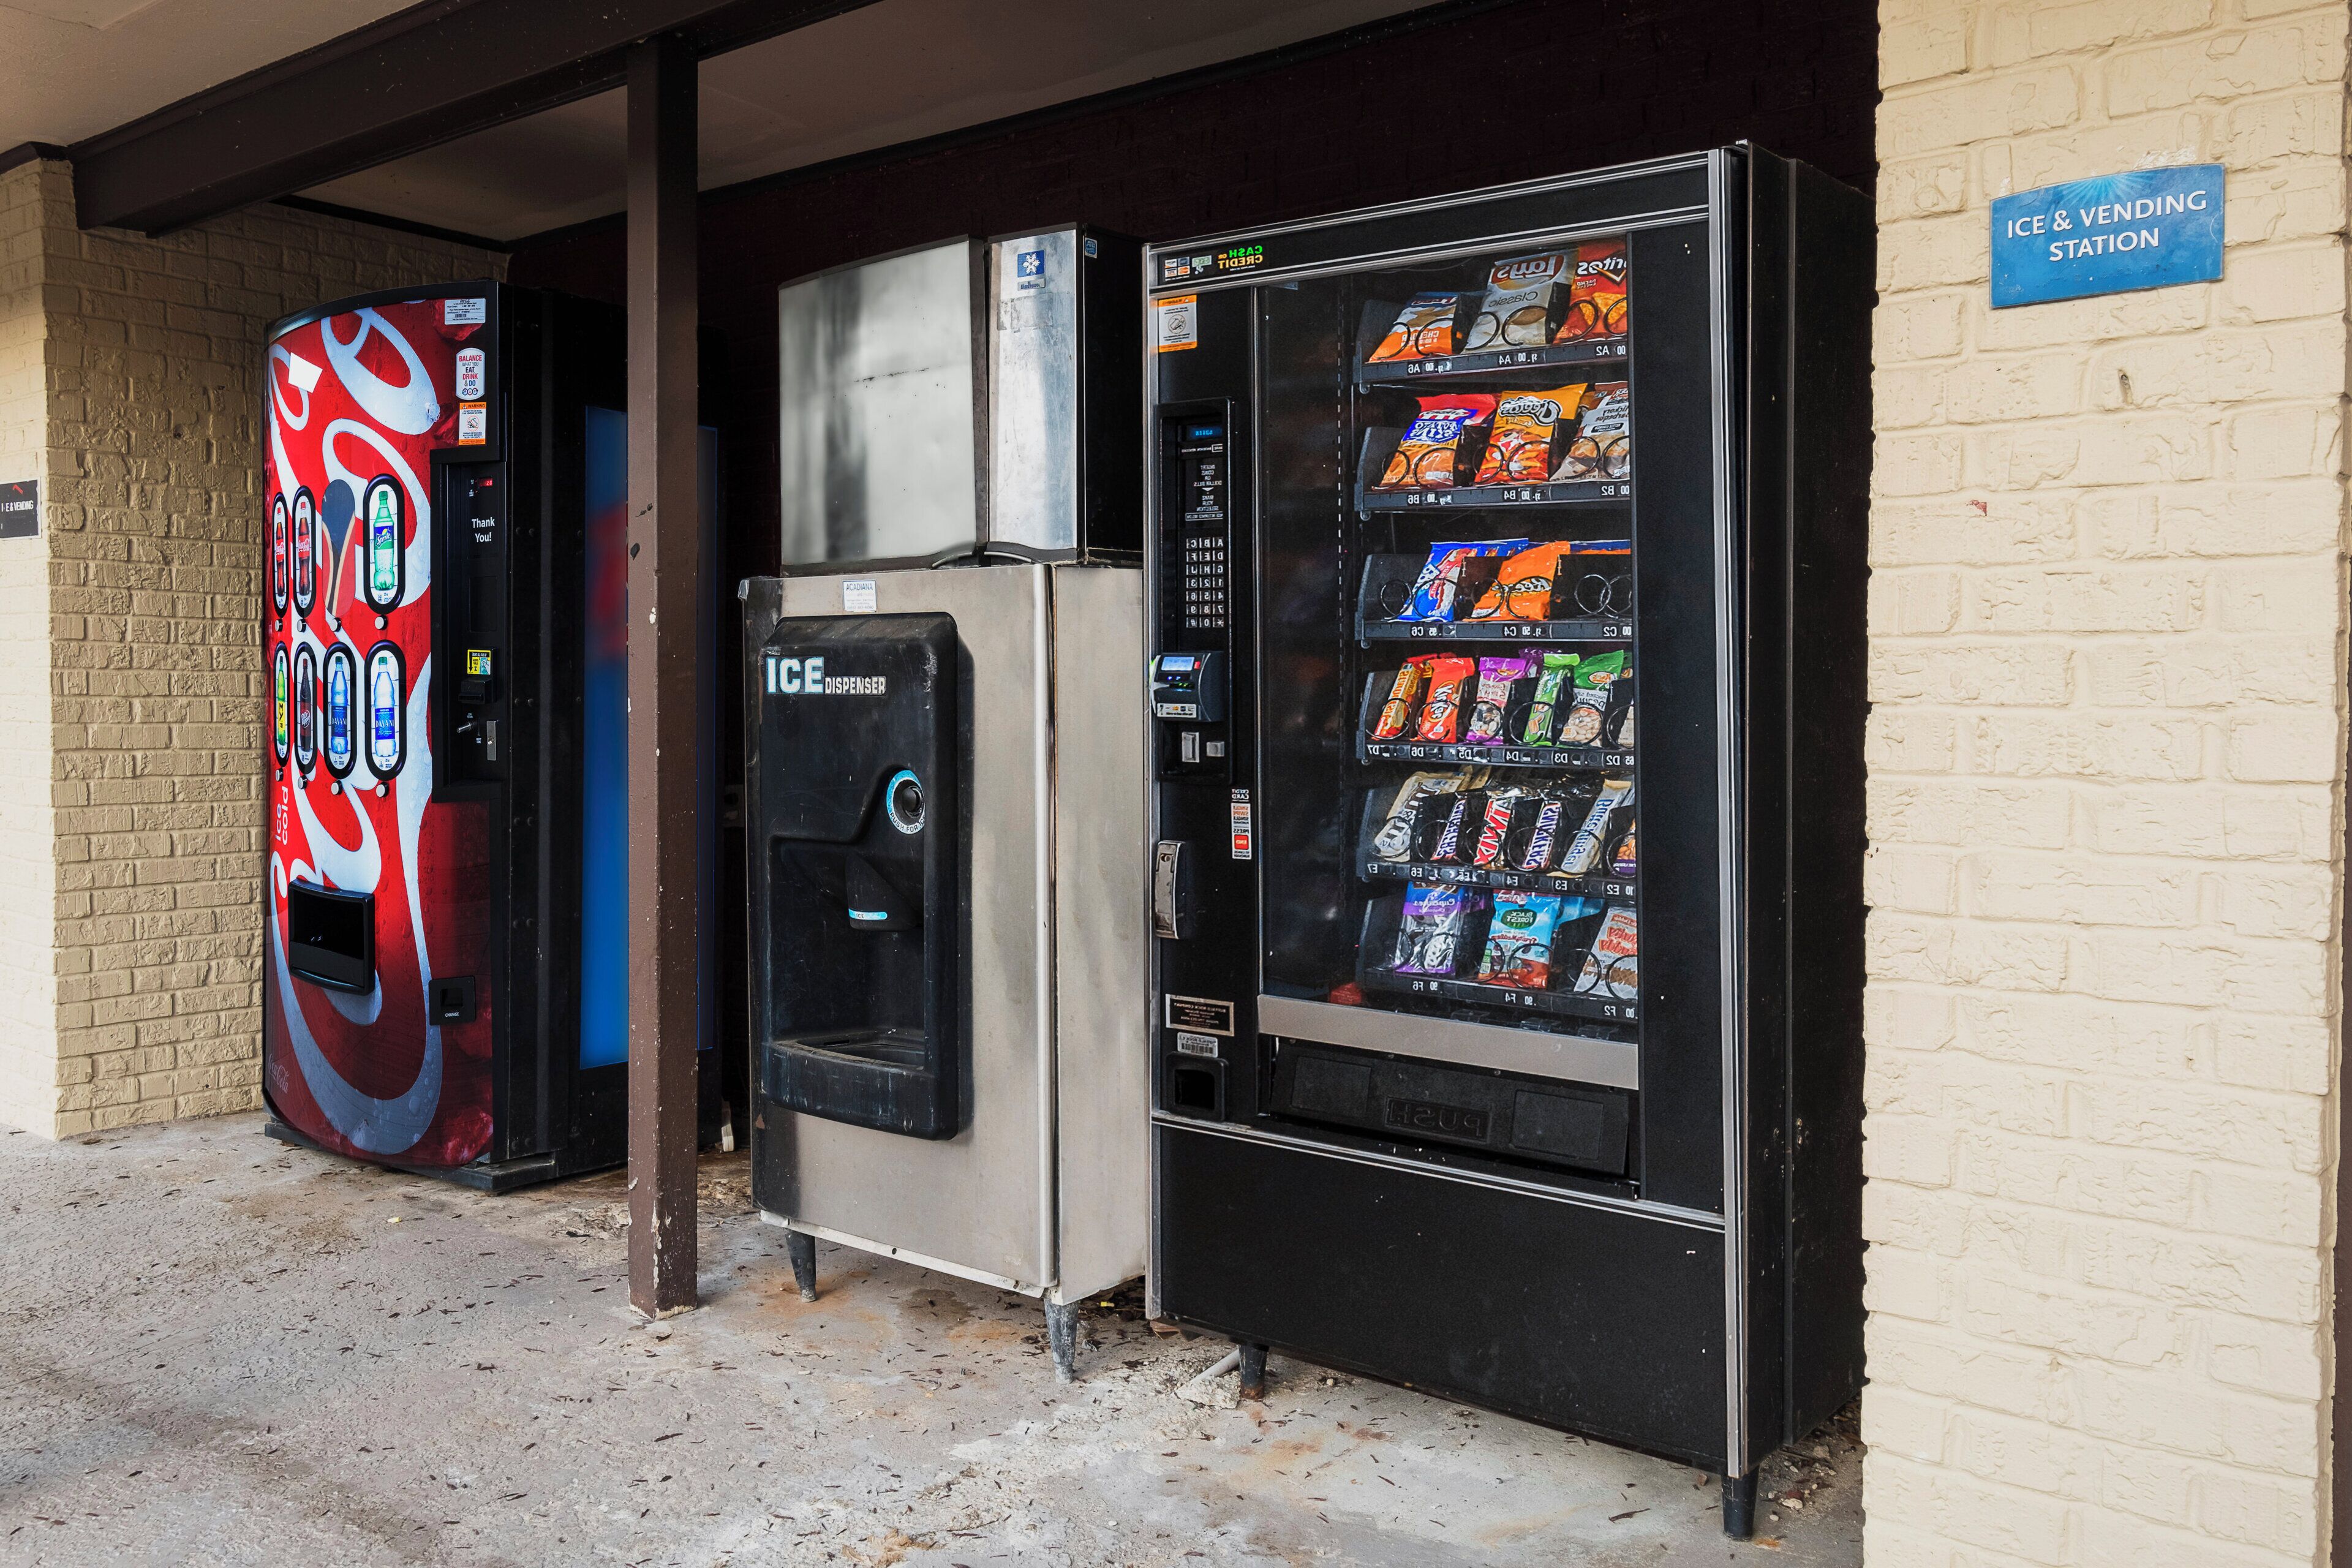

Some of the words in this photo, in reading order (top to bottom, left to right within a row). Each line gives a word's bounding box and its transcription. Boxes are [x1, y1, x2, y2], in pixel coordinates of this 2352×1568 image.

[2008, 214, 2045, 238] ICE
[2052, 209, 2073, 232] &
[2079, 190, 2207, 227] VENDING
[2049, 227, 2159, 262] STATION
[13, 500, 34, 511] VENDING
[472, 517, 495, 528] Thank
[377, 533, 392, 546] Sprite
[475, 532, 492, 542] You!
[767, 657, 824, 693] ICE
[825, 677, 886, 695] DISPENSER
[889, 812, 905, 831] PUSH
[907, 823, 919, 832] FOR
